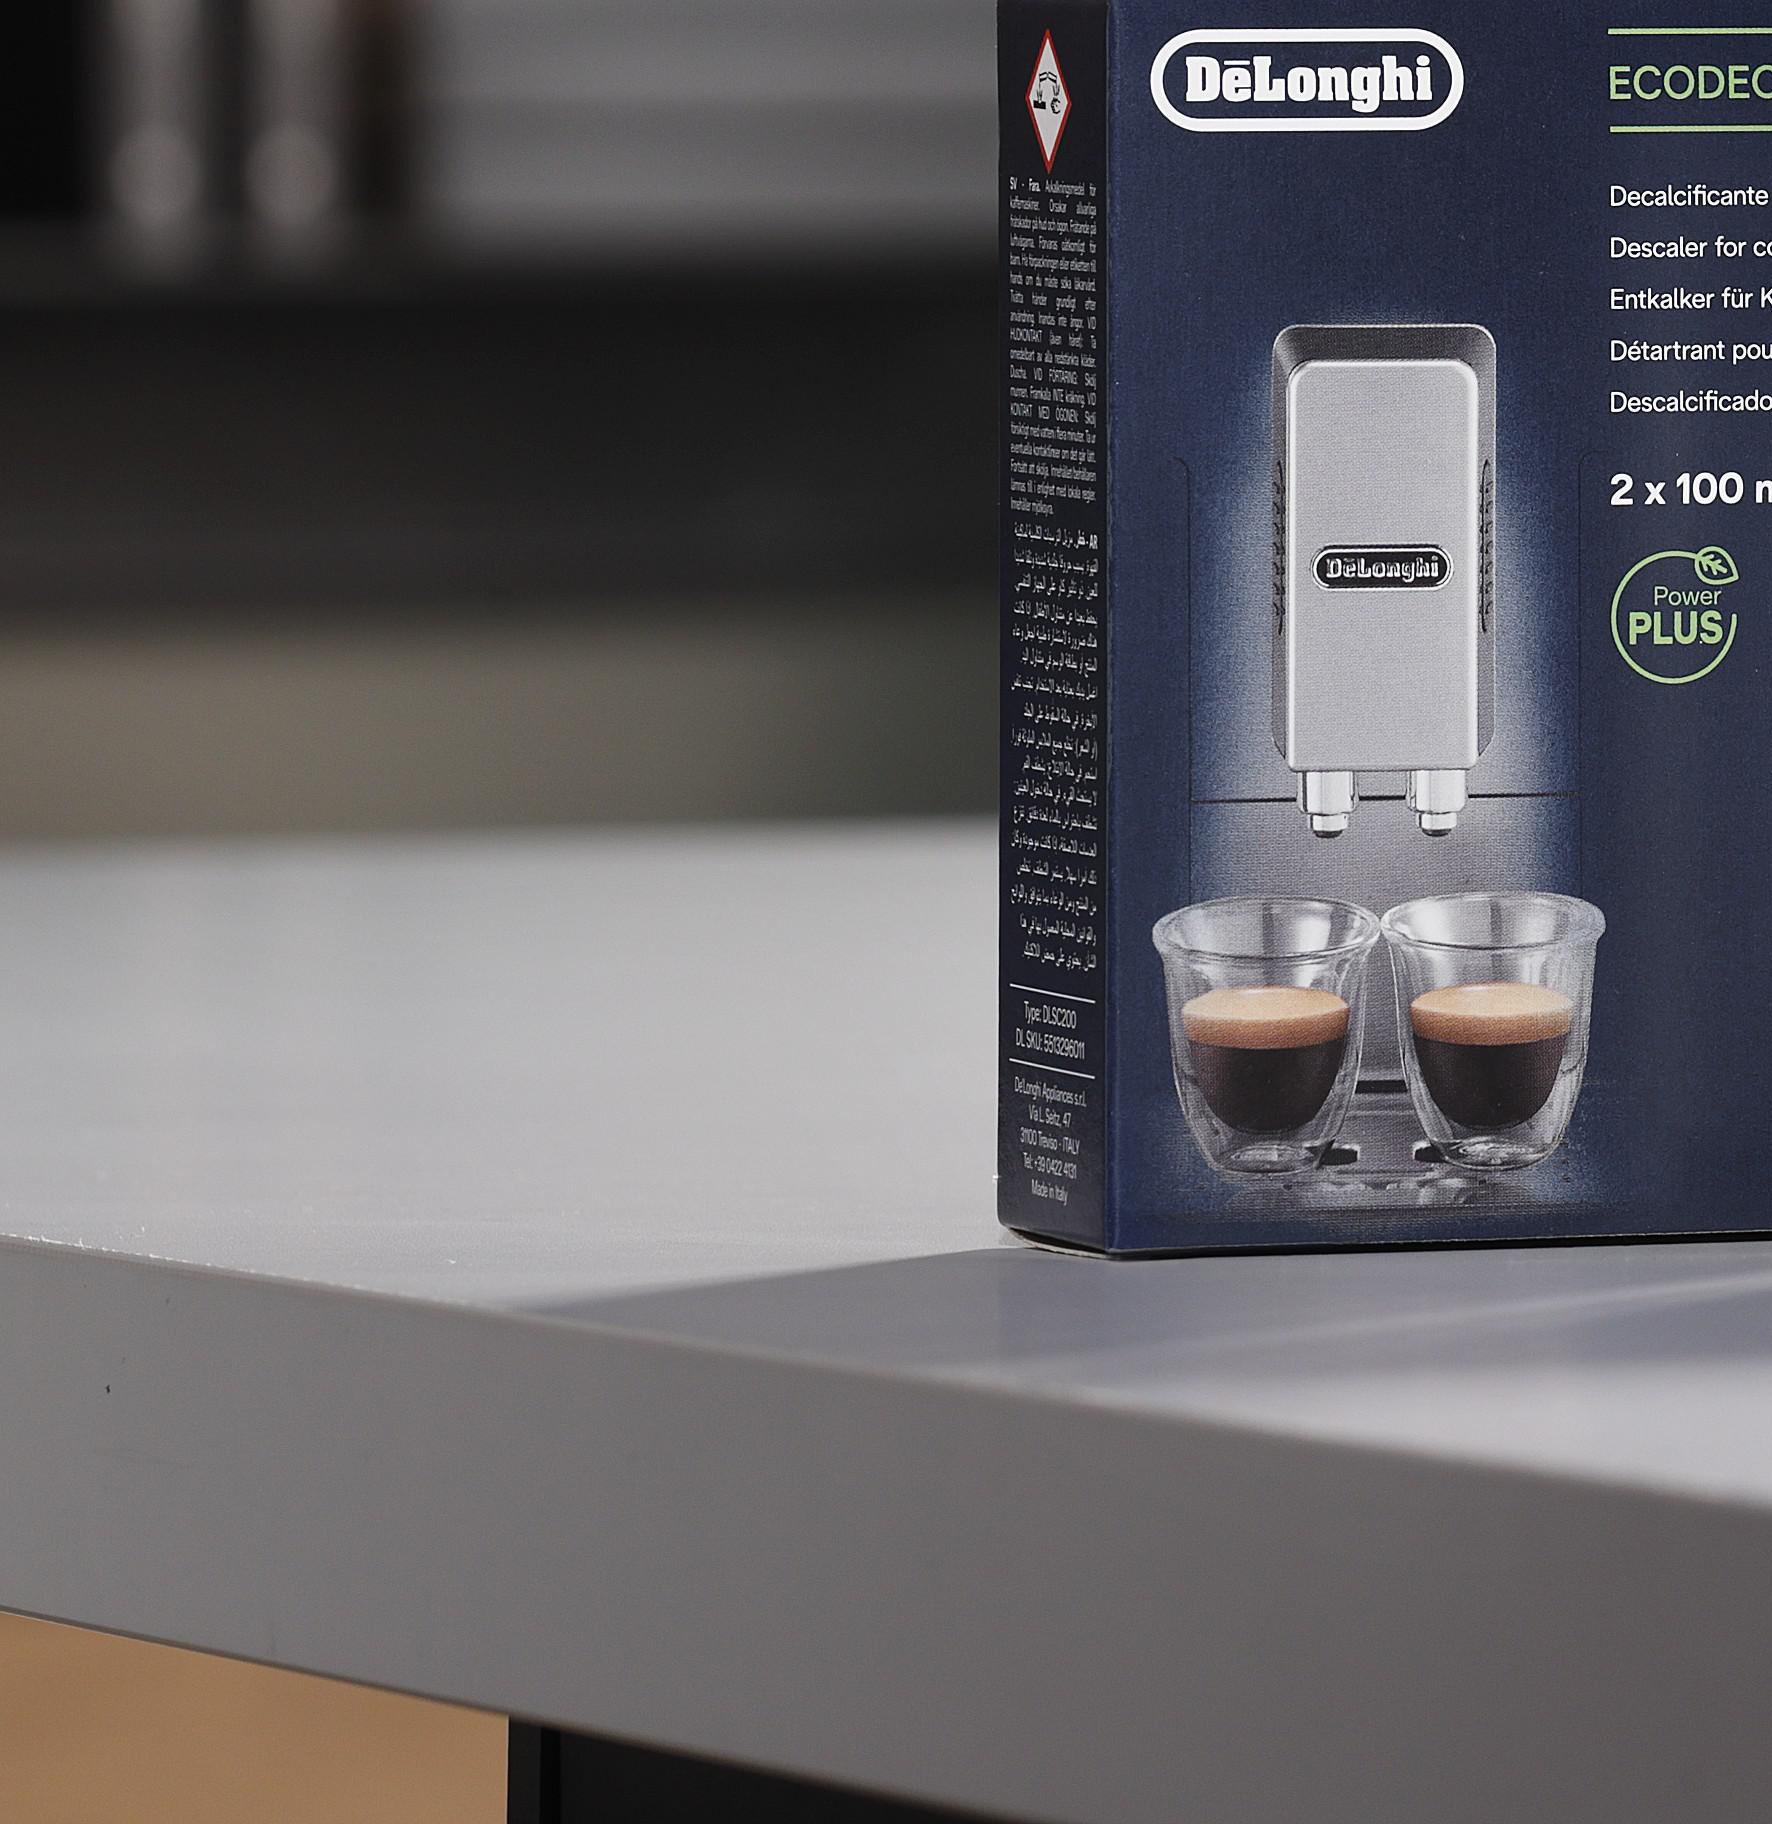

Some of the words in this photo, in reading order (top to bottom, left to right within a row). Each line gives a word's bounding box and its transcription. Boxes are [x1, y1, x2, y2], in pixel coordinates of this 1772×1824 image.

[1610, 184, 1769, 207] Decalcificante
[1610, 235, 1708, 258] Descaler
[1714, 235, 1747, 258] for
[1610, 287, 1715, 310] Entkalker
[1721, 286, 1754, 309] für
[1610, 339, 1726, 362] Détartrant
[1610, 473, 1634, 506] 2
[1644, 481, 1666, 505] x
[1676, 471, 1744, 505] 100
[1654, 586, 1722, 605] Power
[1629, 610, 1724, 645] PLUS
[1024, 1001, 1041, 1024] Type:
[1043, 1004, 1076, 1029] DLSC200
[1016, 1027, 1025, 1047] DL
[1026, 1030, 1042, 1050] SKU:
